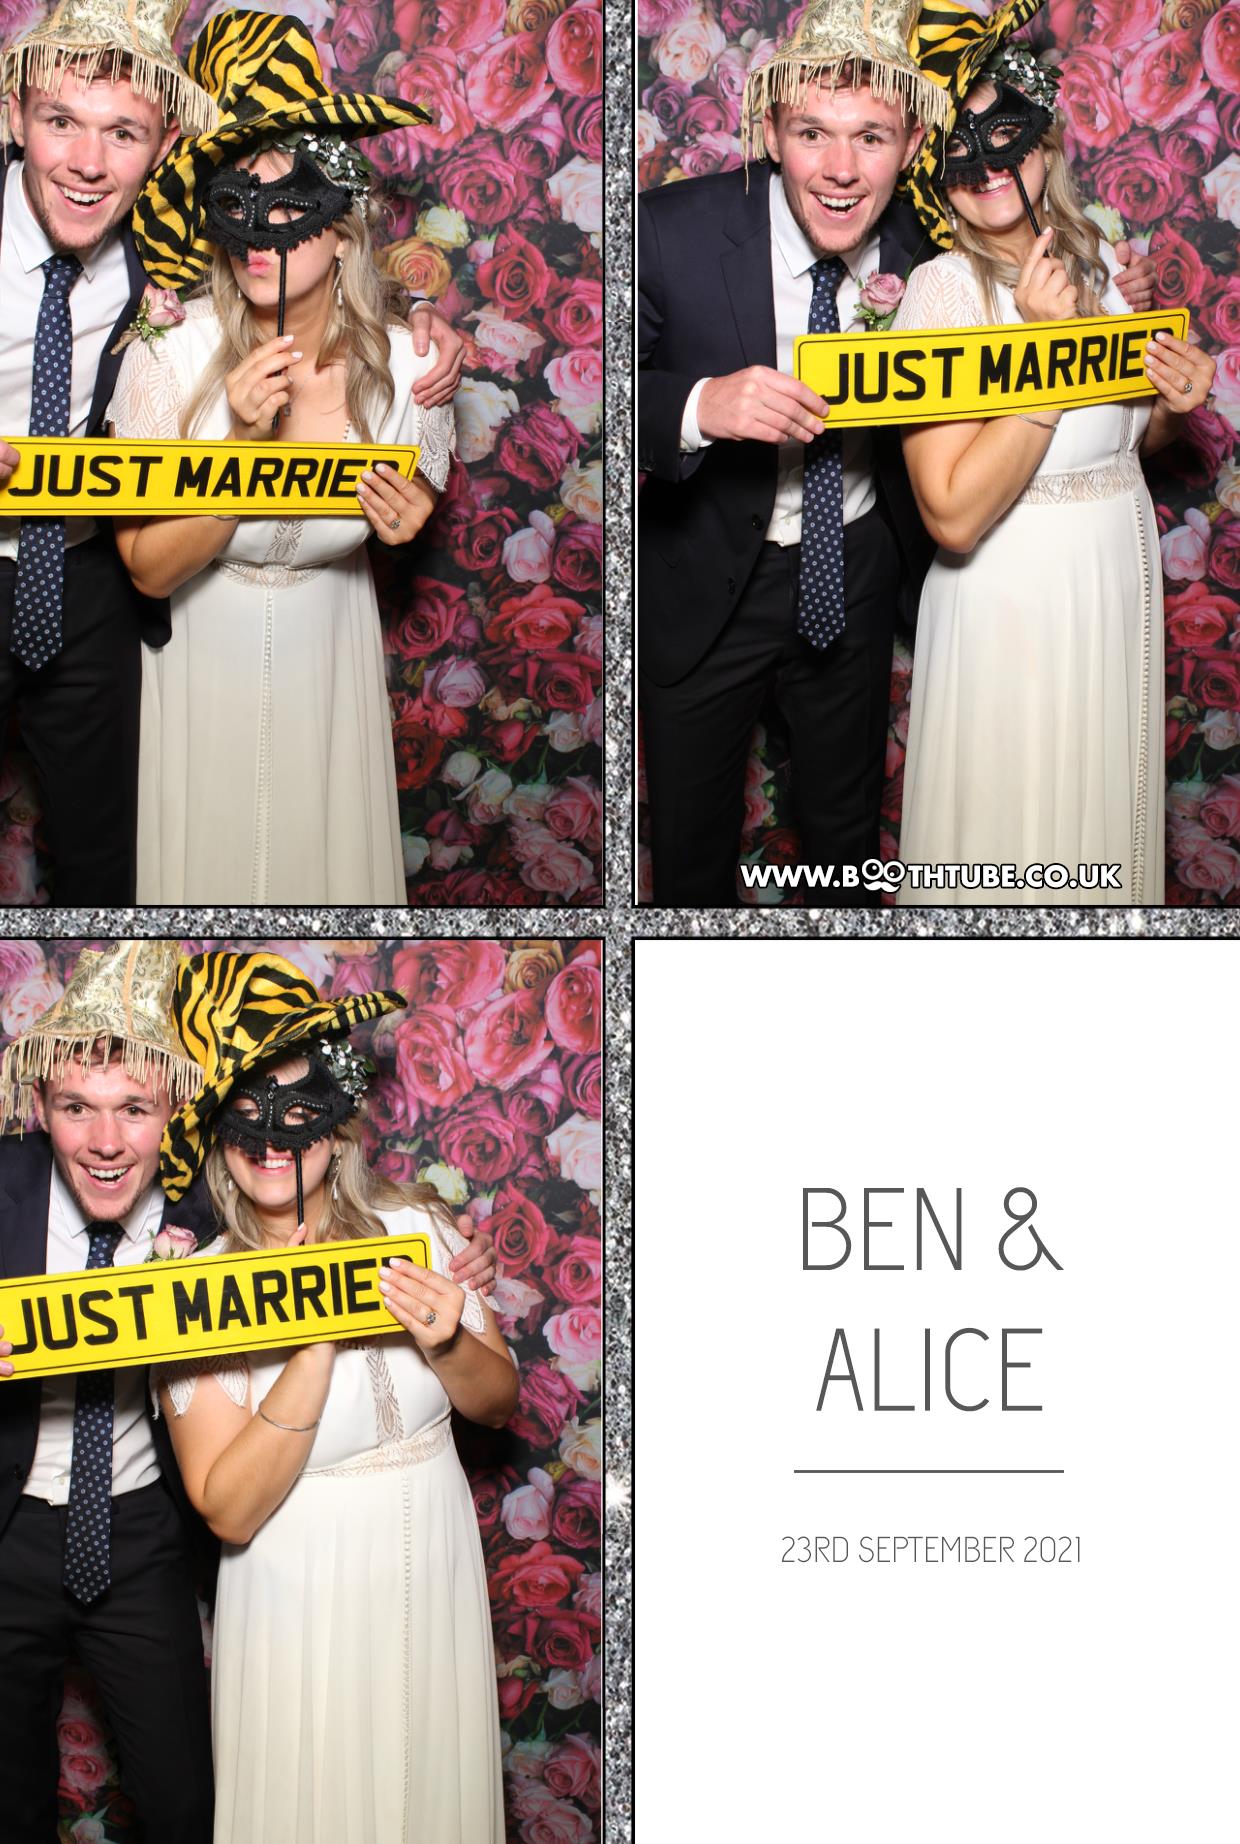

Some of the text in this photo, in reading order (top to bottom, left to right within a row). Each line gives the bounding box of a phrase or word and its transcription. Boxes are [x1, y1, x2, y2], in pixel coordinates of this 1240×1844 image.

[821, 327, 1175, 407] JUST MARRIE
[8, 454, 400, 498] JUST MARRIE
[11, 1255, 414, 1355] JUST MARRIE
